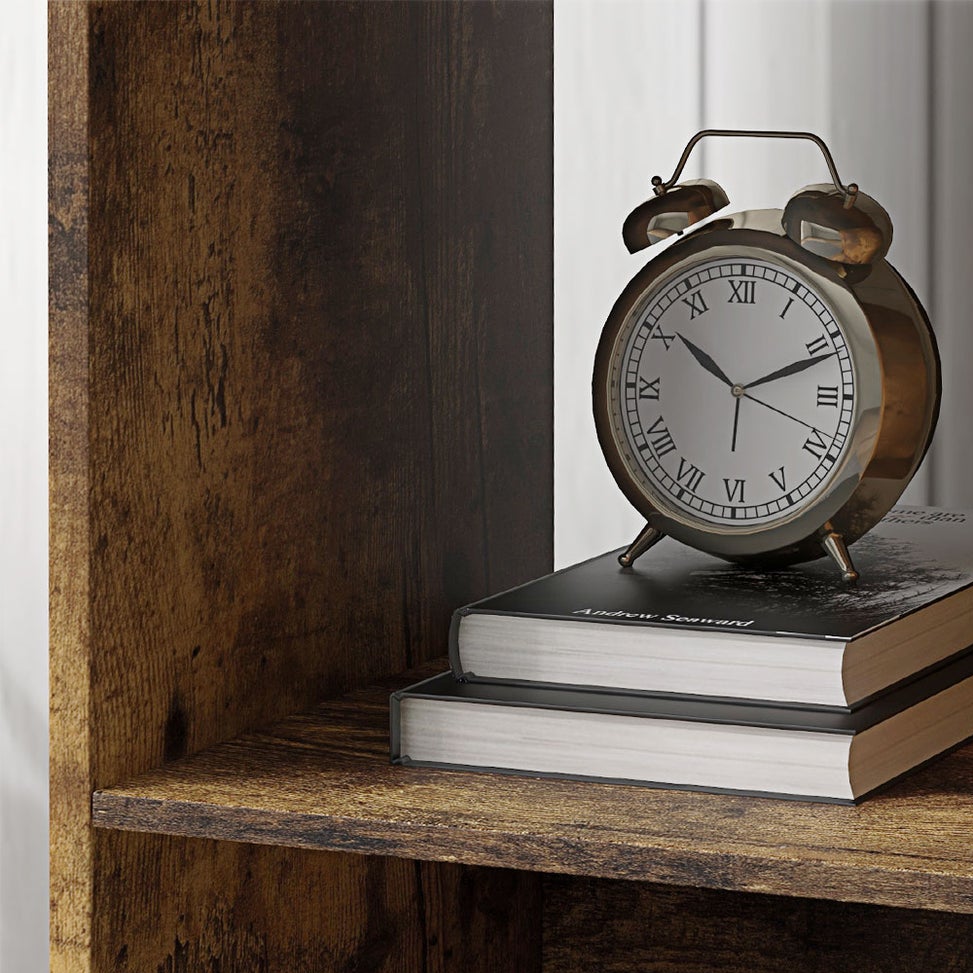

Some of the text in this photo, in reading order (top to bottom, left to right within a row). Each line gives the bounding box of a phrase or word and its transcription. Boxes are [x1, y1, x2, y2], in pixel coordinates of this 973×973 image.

[728, 279, 756, 304] XII
[682, 289, 709, 320] XI
[779, 297, 795, 320] I
[651, 324, 676, 350] X
[805, 334, 829, 356] II
[639, 377, 660, 401] IX
[817, 385, 838, 408] III
[647, 416, 677, 459] VIII
[802, 428, 827, 461] IV
[677, 457, 706, 493] VII
[768, 466, 786, 492] V
[723, 478, 745, 503] VI
[572, 607, 755, 628] Andrew Seaward
